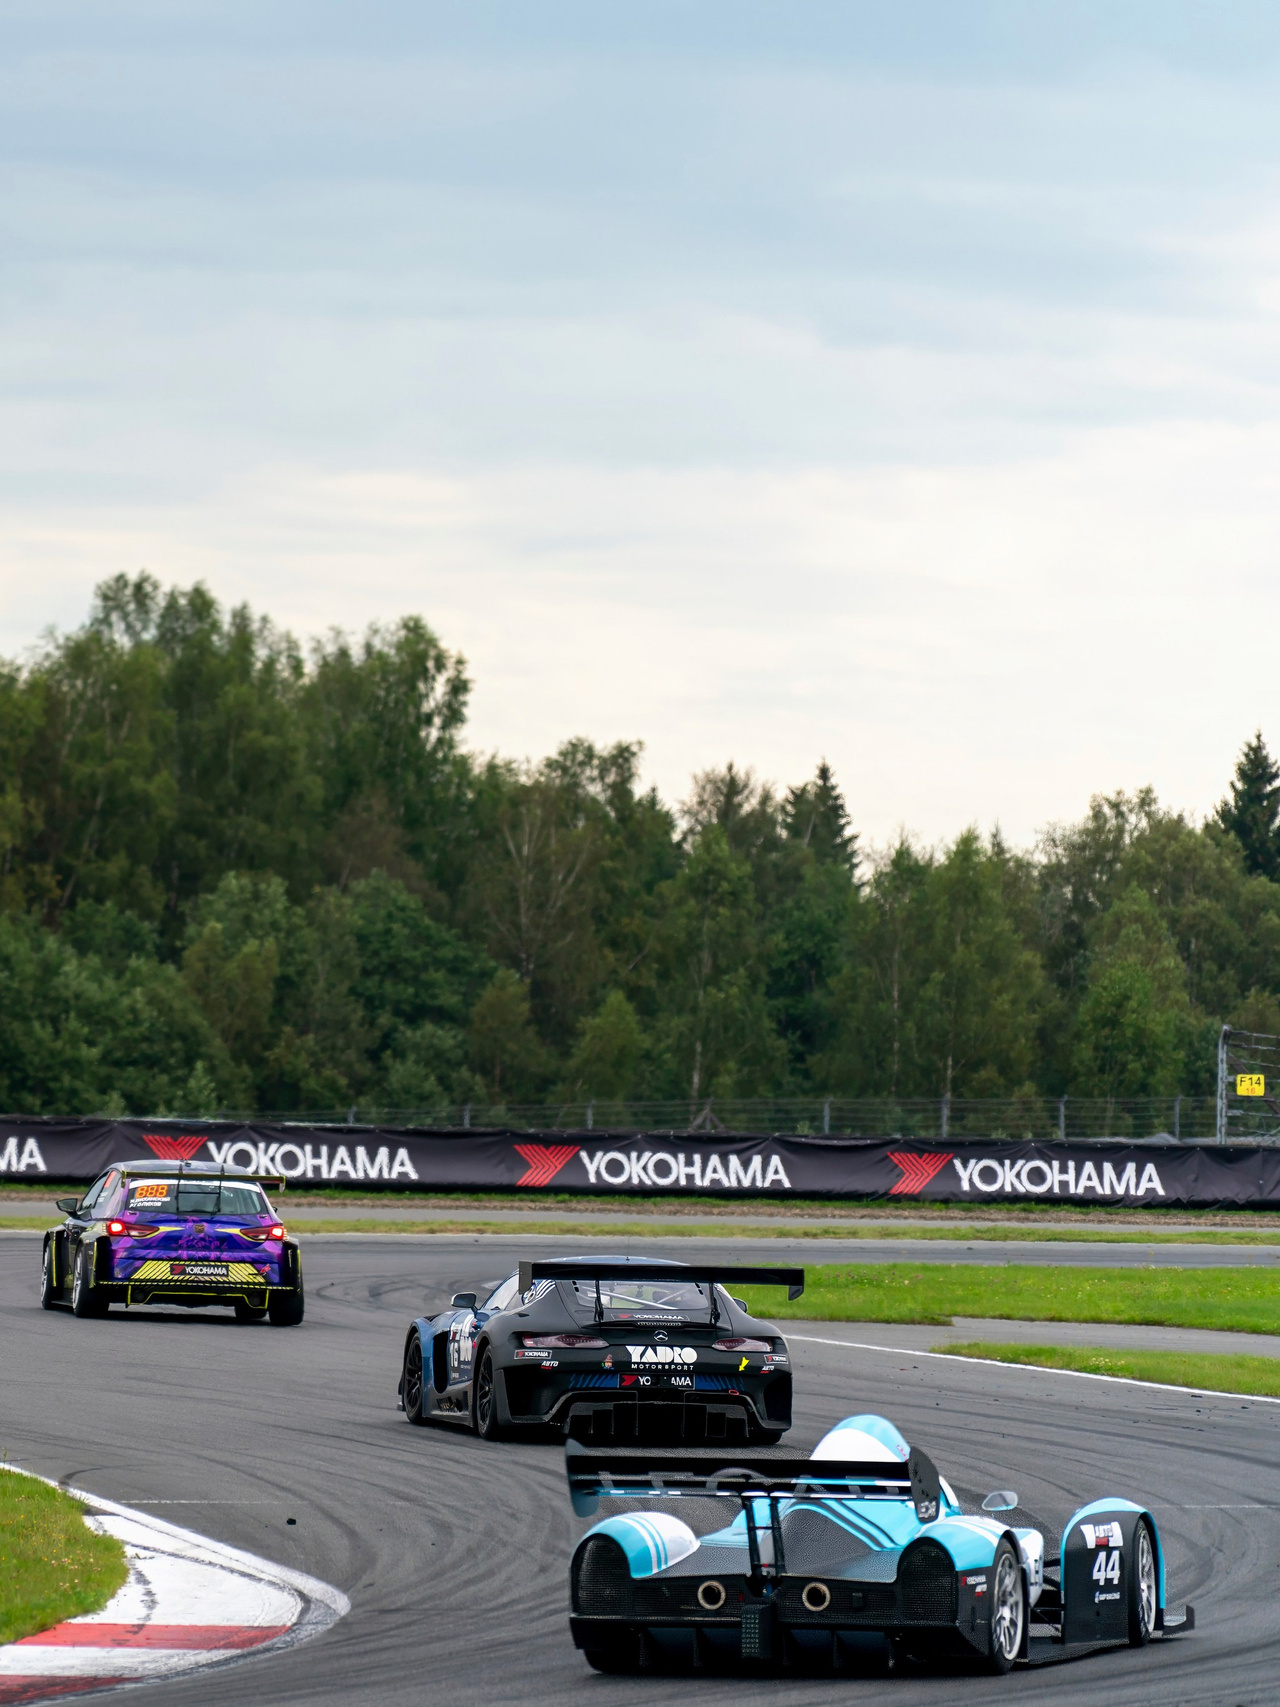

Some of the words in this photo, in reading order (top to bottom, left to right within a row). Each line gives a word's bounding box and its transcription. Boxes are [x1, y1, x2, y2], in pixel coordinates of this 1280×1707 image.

[1240, 1076, 1261, 1086] F14
[206, 1141, 420, 1180] YOKOHAMA
[579, 1150, 792, 1189] YOKOHAMA
[953, 1158, 1166, 1197] YOKOHAMA
[135, 1184, 168, 1199] 888
[185, 1266, 227, 1275] YOKOHAMA
[625, 1345, 698, 1364] YADRO
[638, 1376, 692, 1386] YOAMA
[1092, 1549, 1121, 1586] 44
